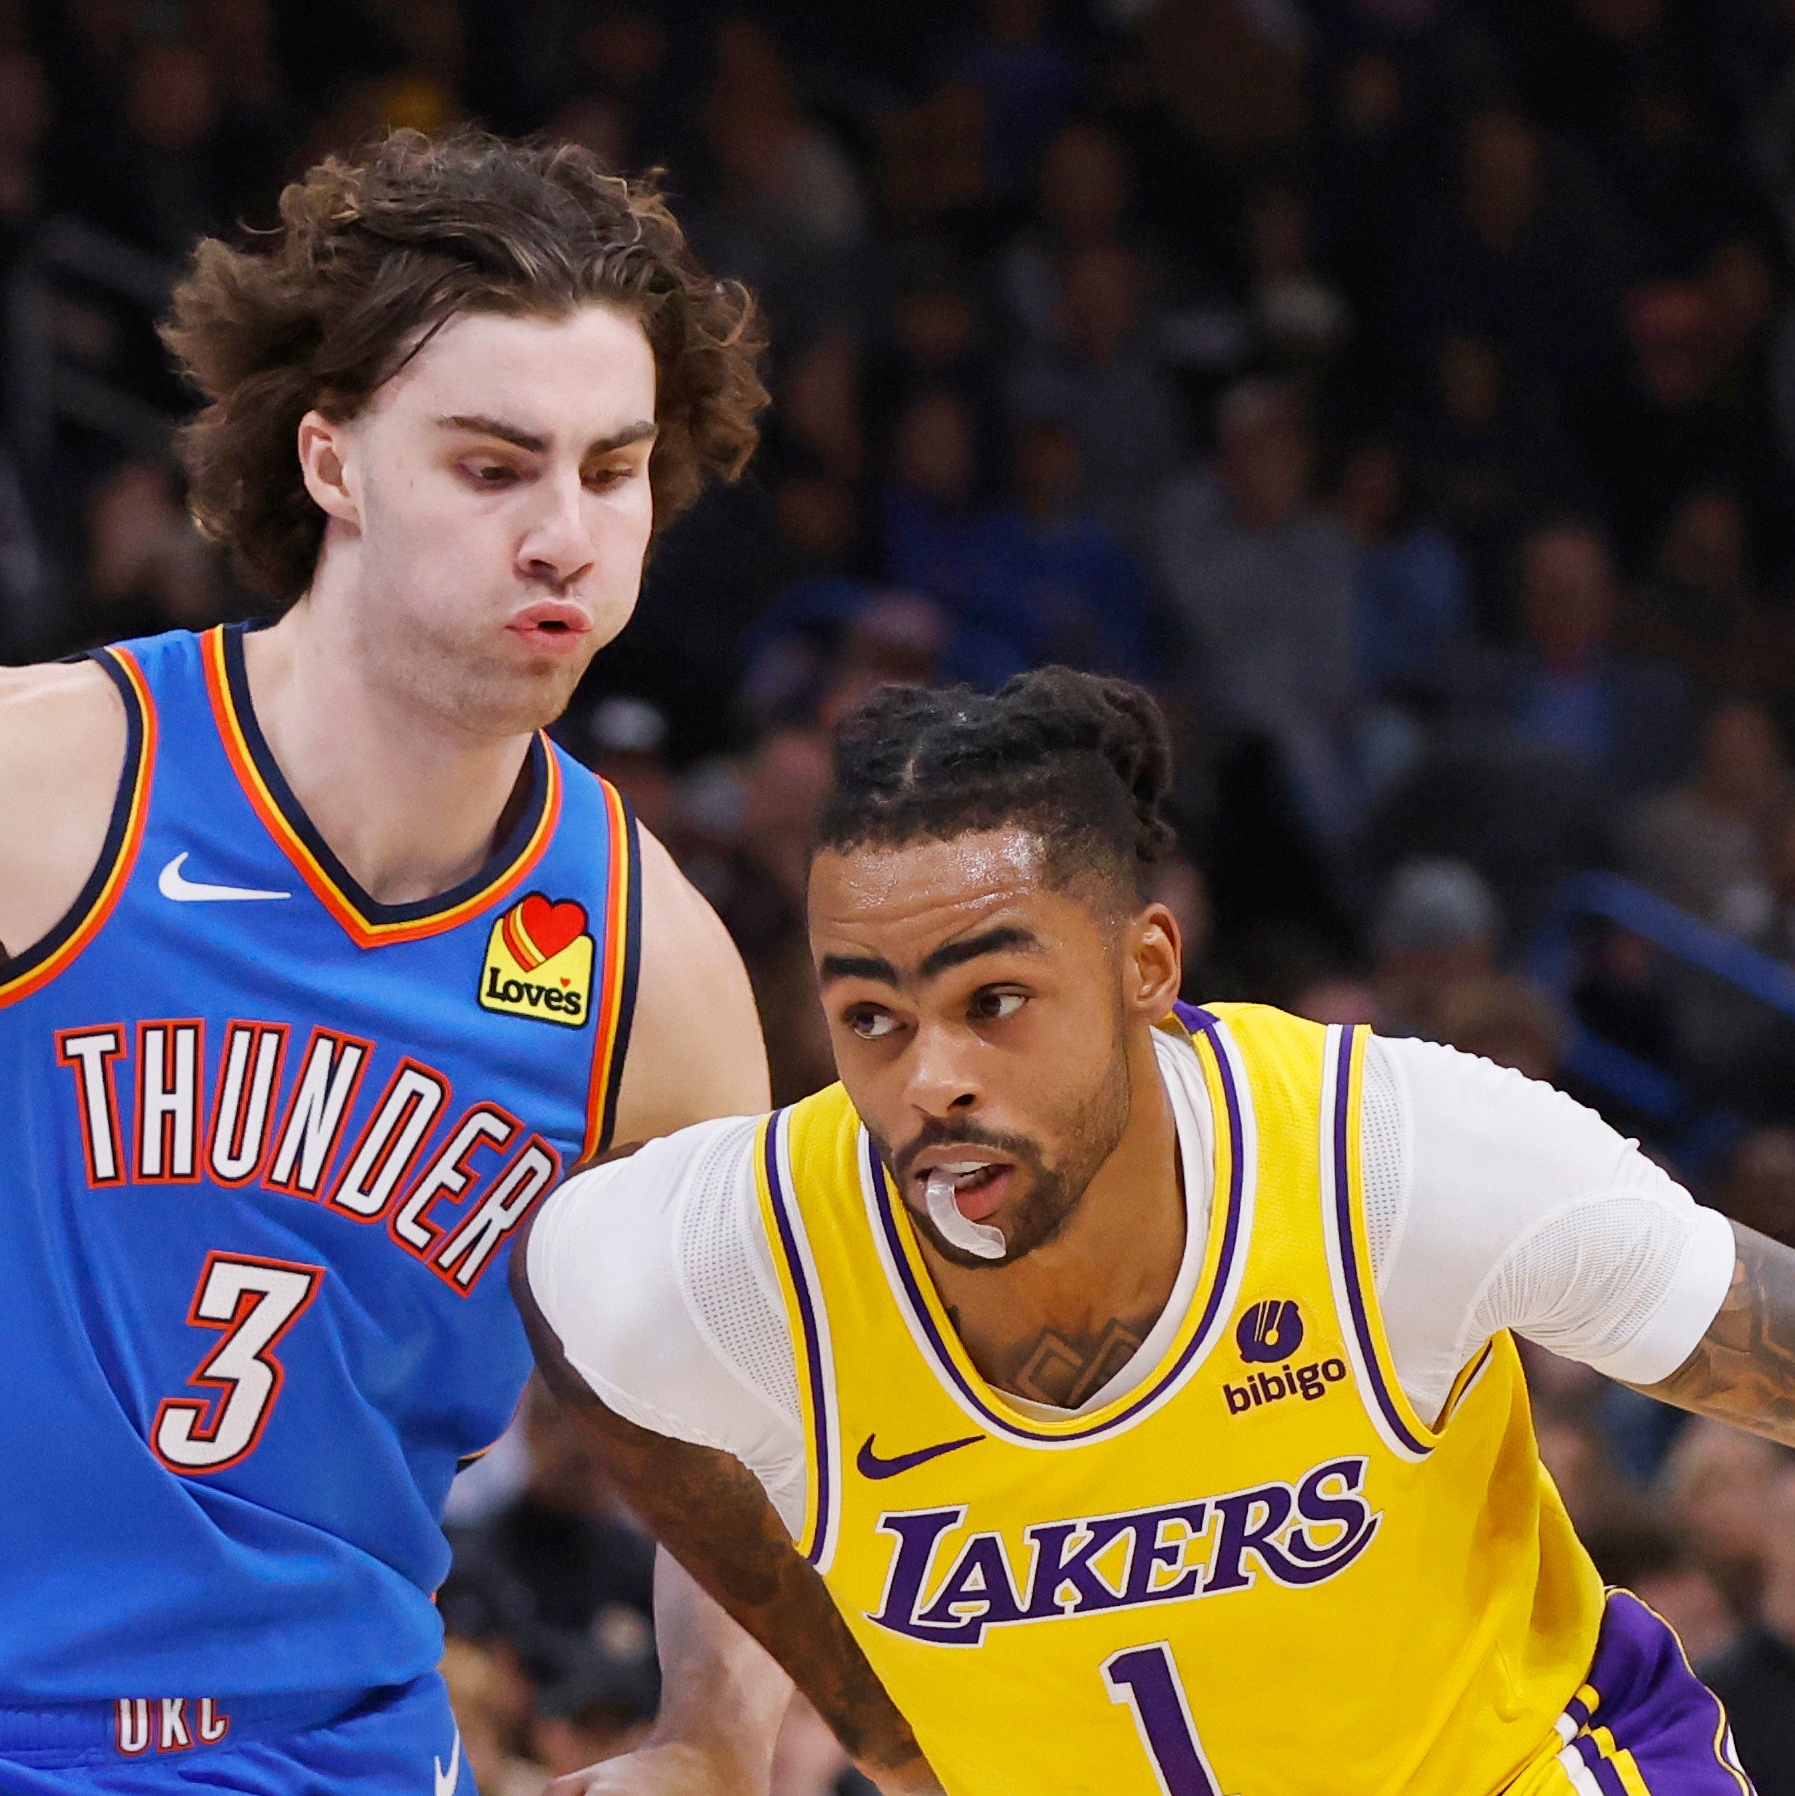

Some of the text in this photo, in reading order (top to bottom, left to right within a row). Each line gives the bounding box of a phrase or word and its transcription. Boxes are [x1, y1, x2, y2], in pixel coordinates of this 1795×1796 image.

[54, 1018, 564, 1298] THUNDER
[149, 1249, 326, 1475] 3
[1223, 1358, 1347, 1416] bibigo
[861, 1455, 1384, 1649] LAKERS
